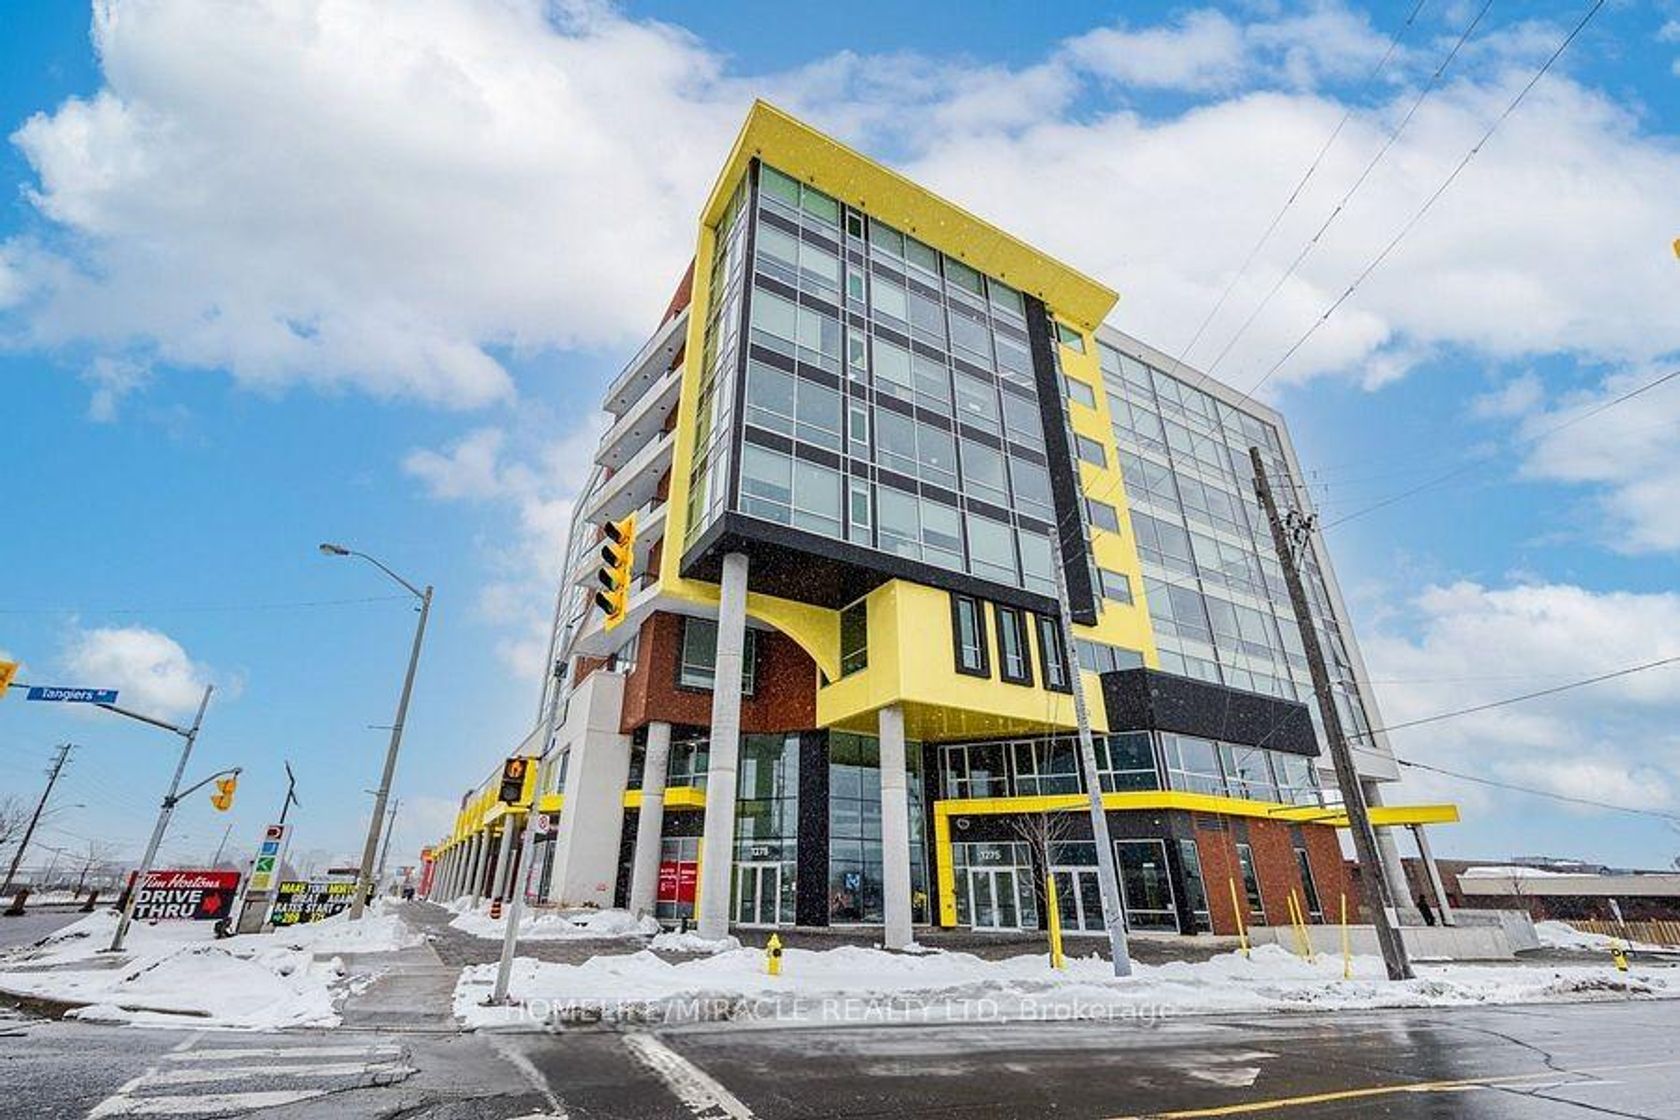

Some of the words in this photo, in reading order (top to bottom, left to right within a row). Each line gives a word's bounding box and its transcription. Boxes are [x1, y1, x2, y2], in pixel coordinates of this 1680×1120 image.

[43, 687, 94, 700] Tangiers
[142, 874, 164, 888] Tim
[167, 874, 220, 888] Hortons
[281, 883, 306, 895] MAKE
[139, 890, 203, 903] DRIVE
[136, 904, 197, 918] THRU
